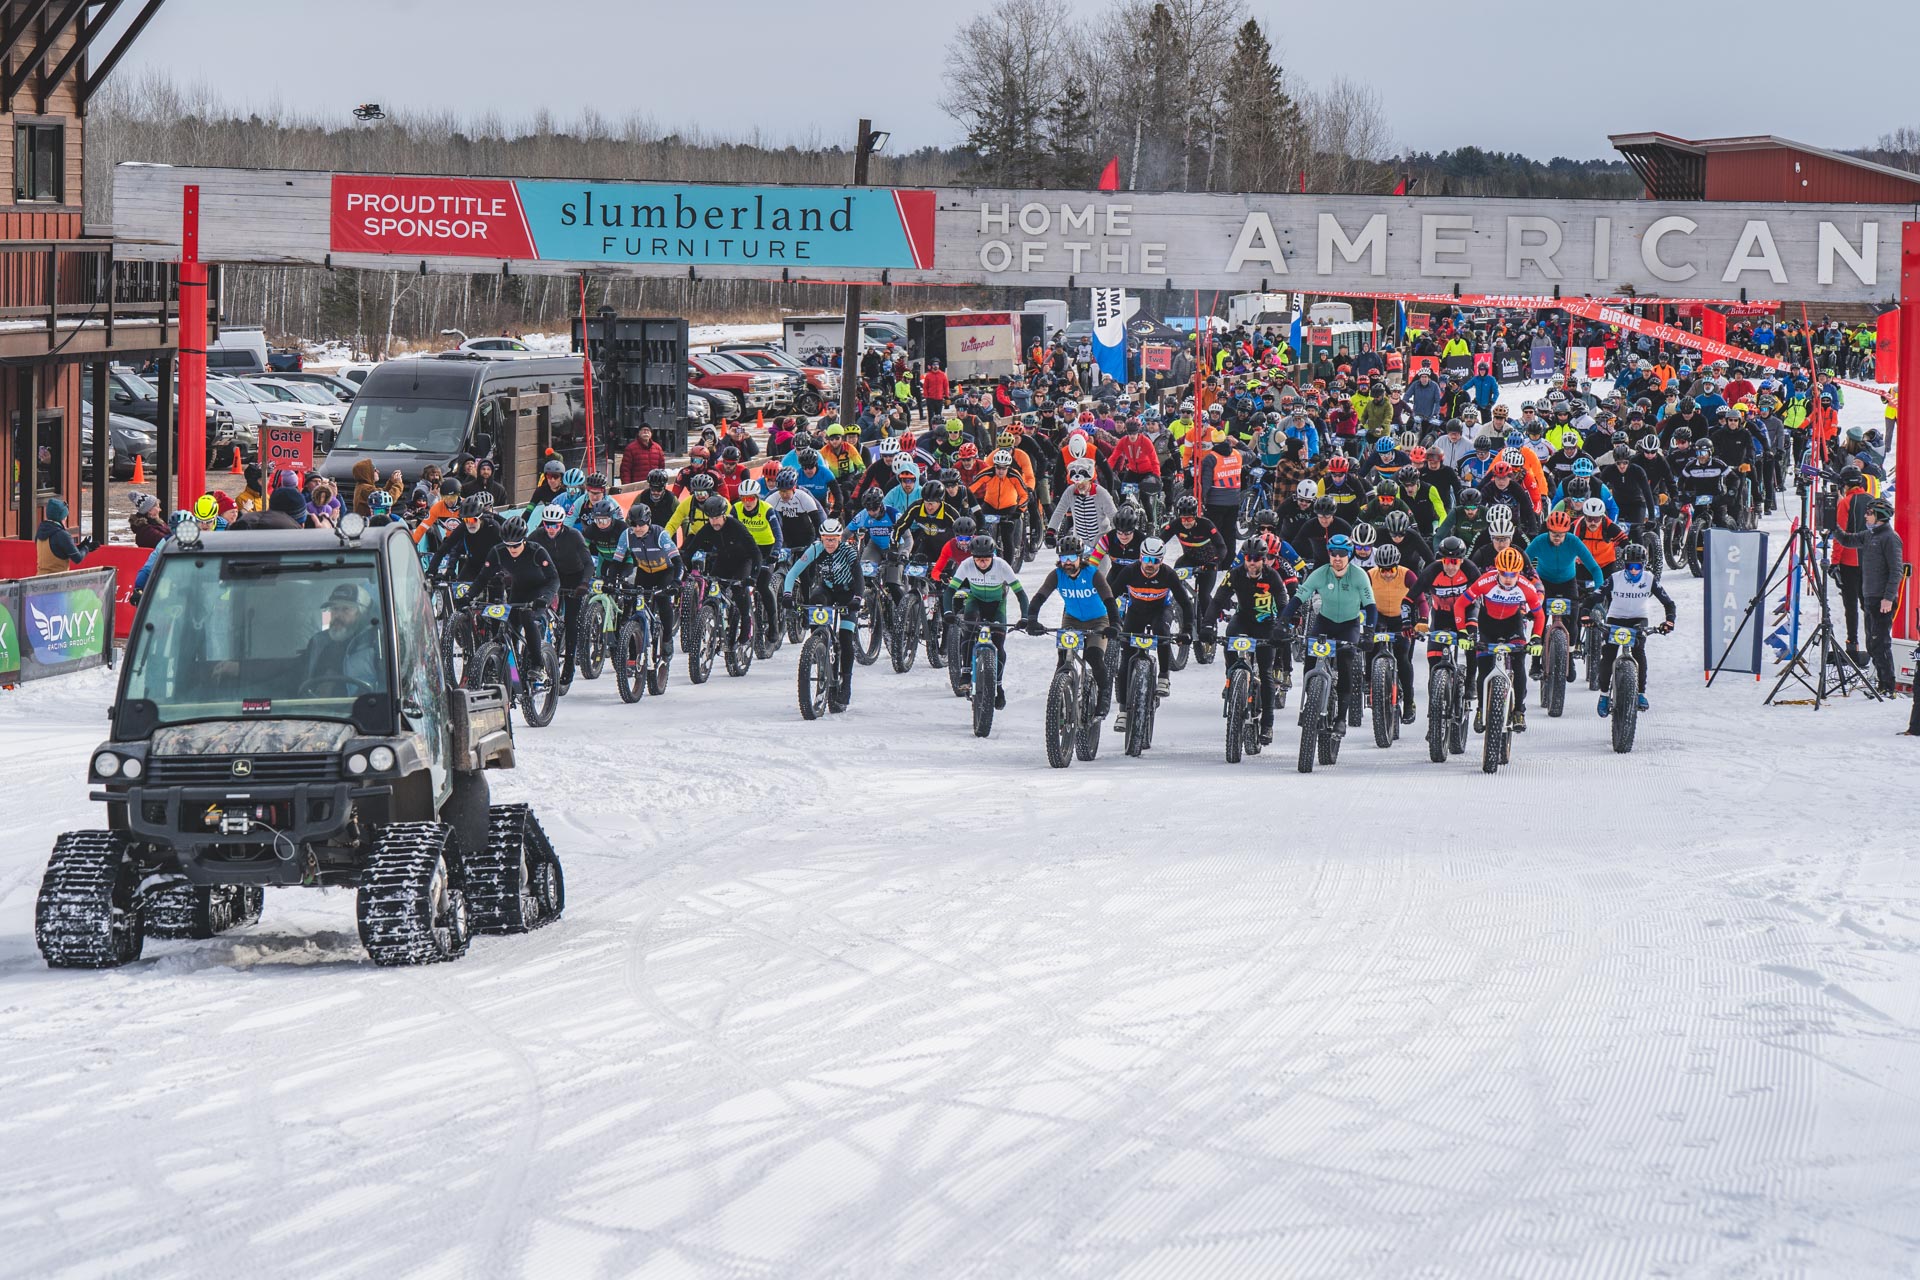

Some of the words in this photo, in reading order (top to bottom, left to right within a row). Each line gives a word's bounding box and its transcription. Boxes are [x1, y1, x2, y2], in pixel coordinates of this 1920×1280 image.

[347, 193, 435, 214] PROUD
[438, 196, 507, 217] TITLE
[561, 191, 854, 232] slumberland
[363, 217, 488, 240] SPONSOR
[980, 202, 1133, 236] HOME
[602, 236, 811, 259] FURNITURE
[979, 240, 1048, 273] OF
[1063, 241, 1167, 275] THE
[1224, 210, 1879, 286] AMERICAN
[960, 336, 995, 353] Untapped
[1599, 308, 1642, 331] BIRKIE
[1653, 326, 1674, 340] Ski.
[1675, 332, 1703, 350] Run.
[1705, 342, 1733, 359] Bike.
[1736, 352, 1769, 367] Live!
[1148, 355, 1164, 363] Two
[270, 429, 302, 442] Gate
[271, 445, 299, 459] One
[1491, 593, 1522, 601] MNJRC
[49, 608, 98, 642] ONYX
[48, 641, 67, 651] RACING
